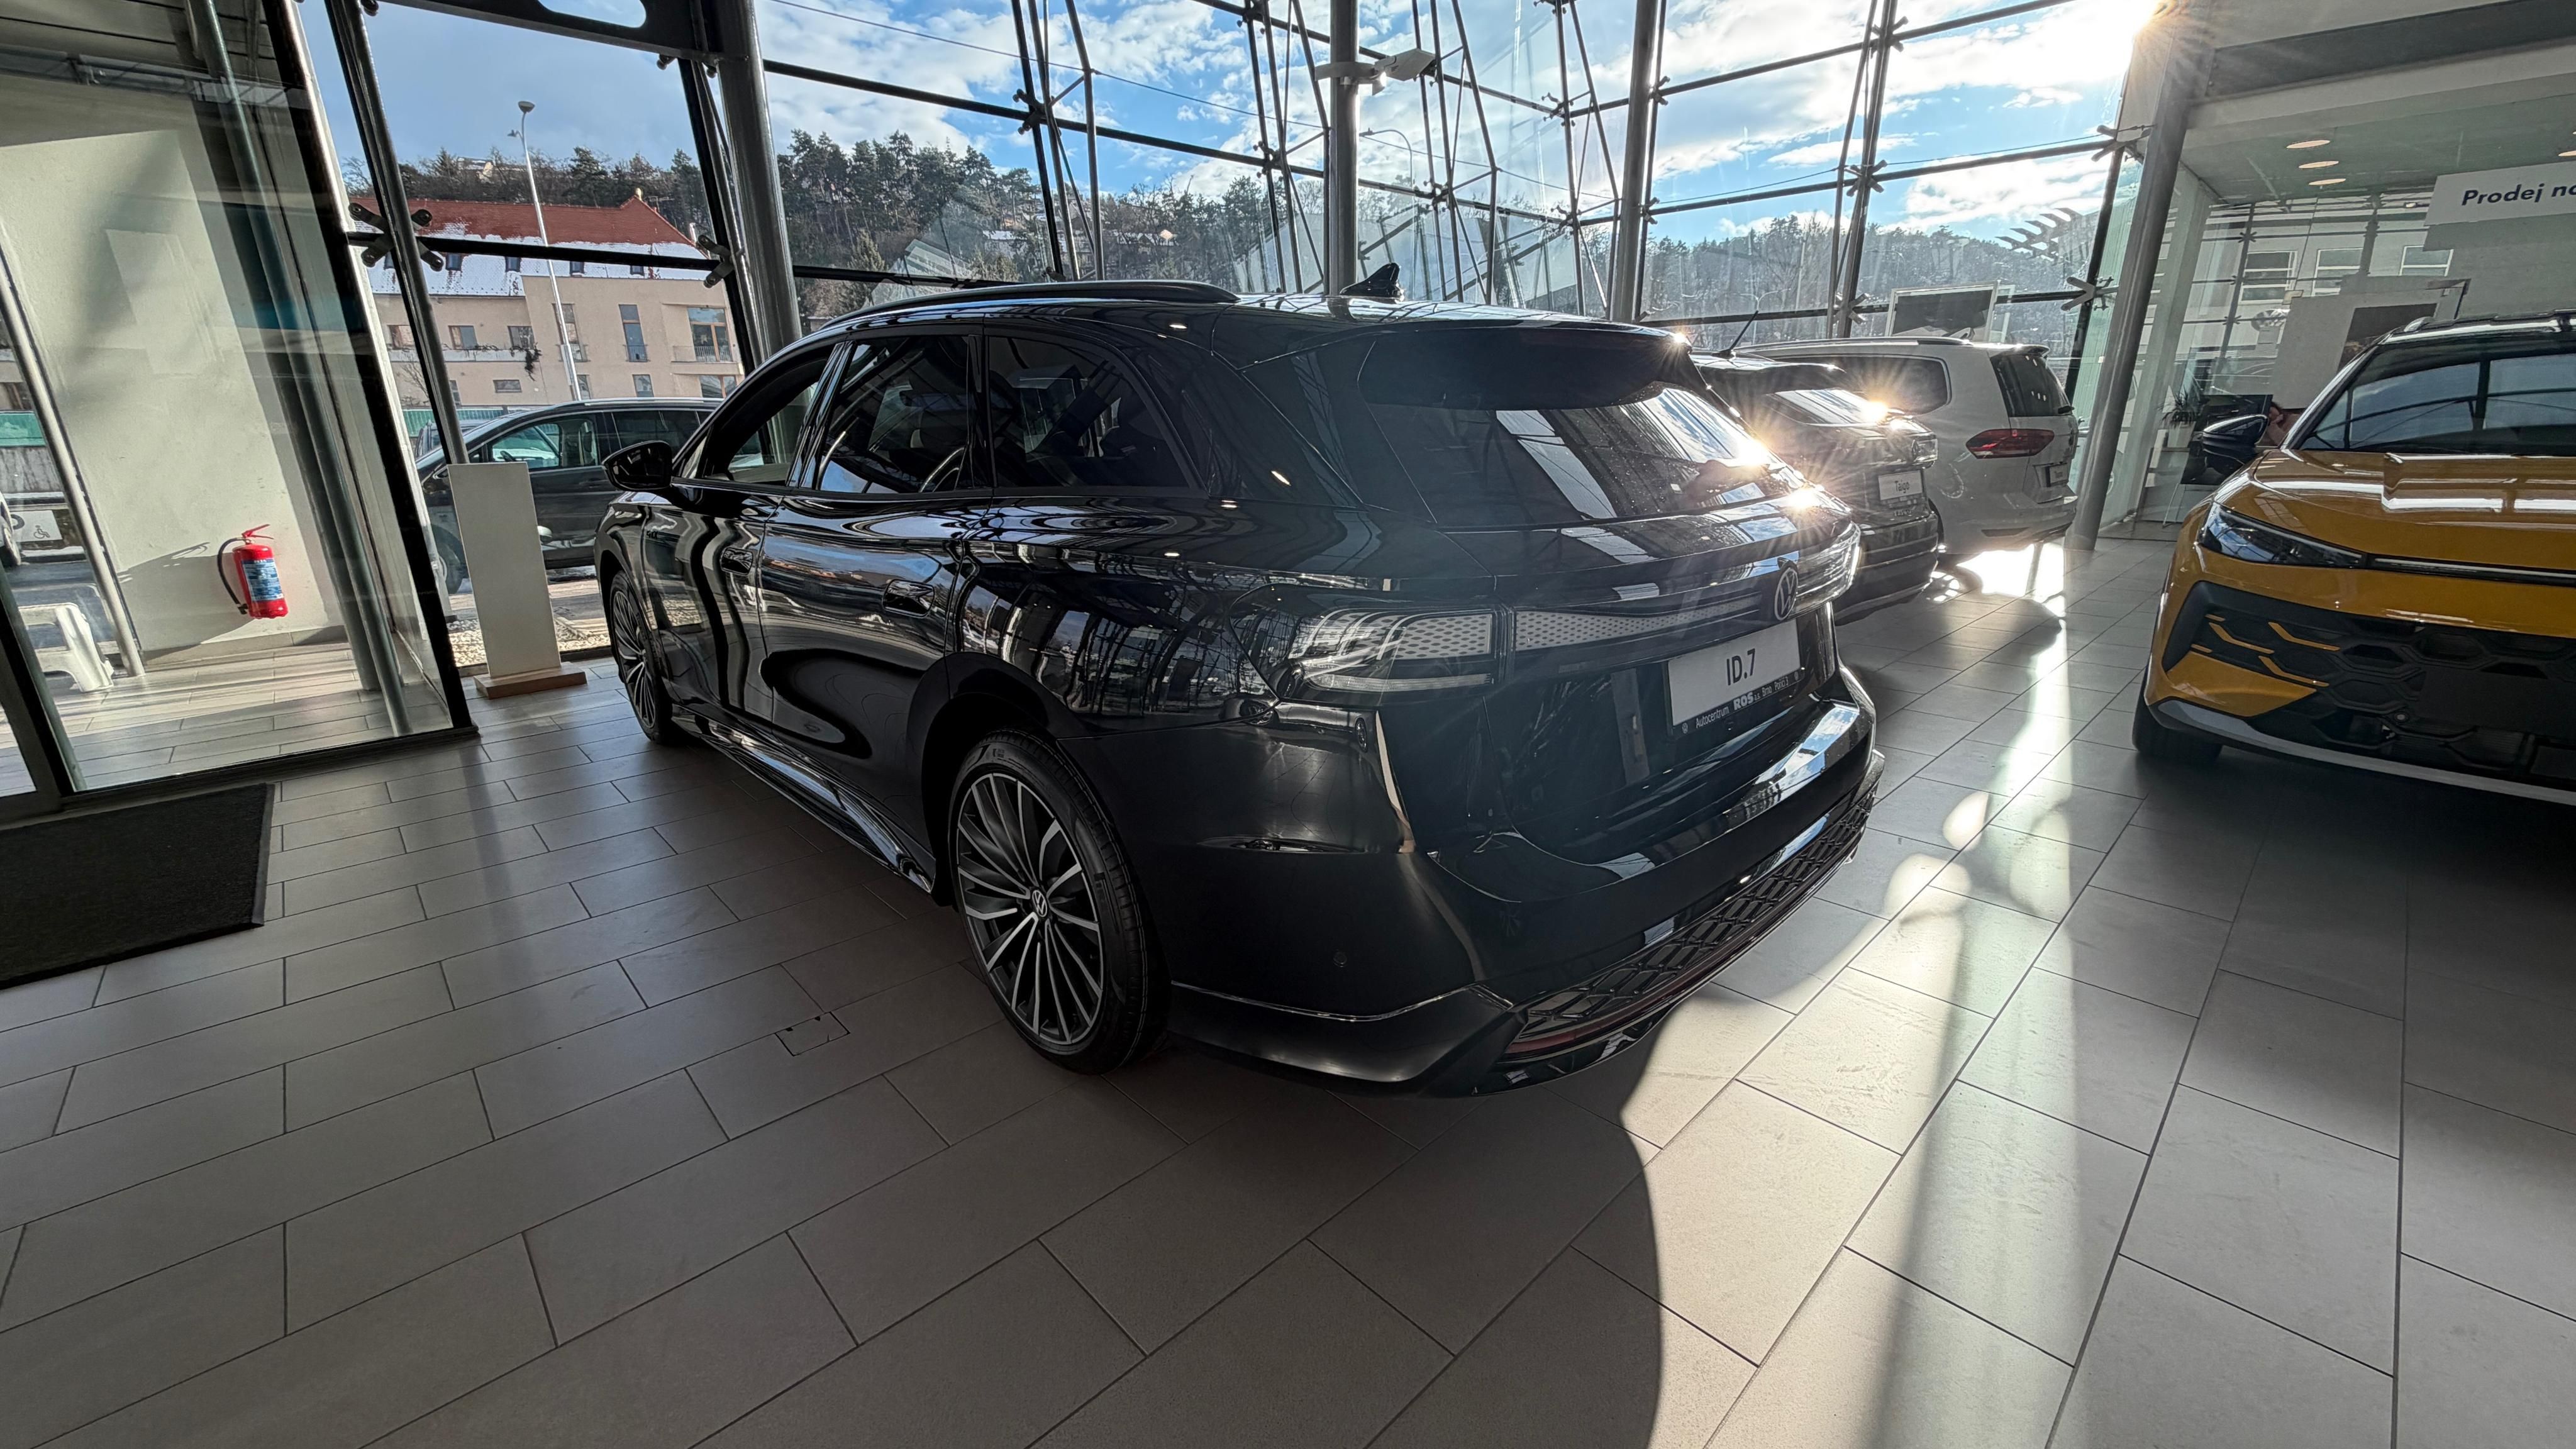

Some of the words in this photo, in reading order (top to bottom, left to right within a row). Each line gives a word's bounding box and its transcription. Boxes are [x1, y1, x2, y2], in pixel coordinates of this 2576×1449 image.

[2461, 182, 2545, 206] Prodej
[1894, 480, 1910, 494] Taigo
[1726, 648, 1755, 686] ID.7
[1696, 706, 1729, 729] Autocentrum
[1733, 692, 1754, 711] ROS
